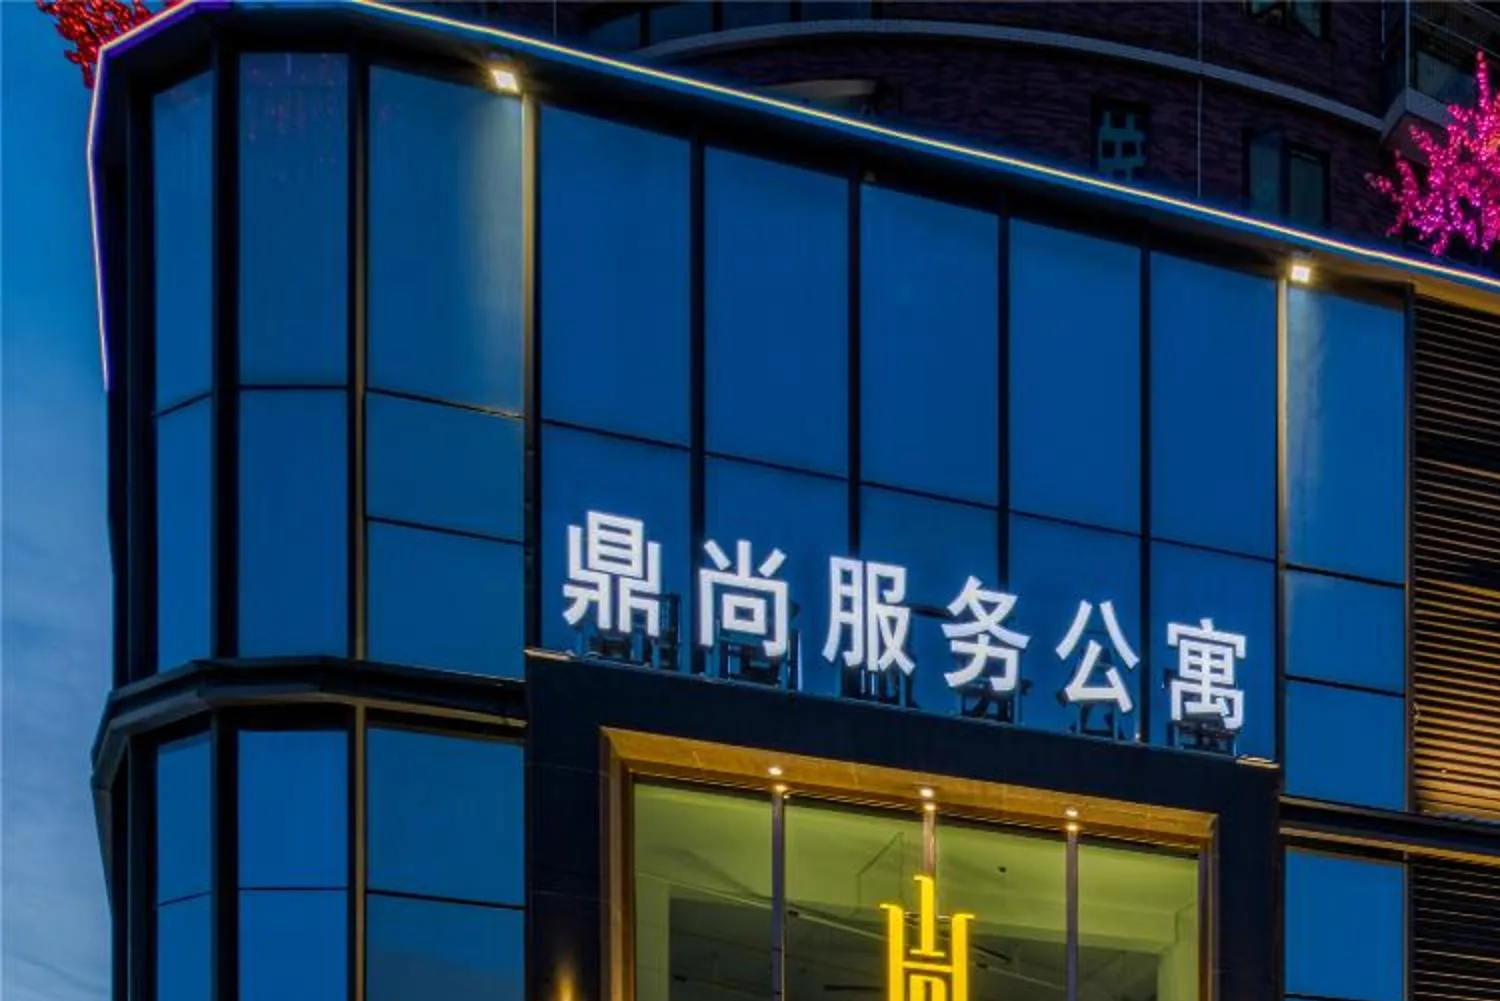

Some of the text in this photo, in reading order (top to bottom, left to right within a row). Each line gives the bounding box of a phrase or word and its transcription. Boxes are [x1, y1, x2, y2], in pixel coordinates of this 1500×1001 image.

[562, 510, 1247, 731] 鼎尚服务公寓
